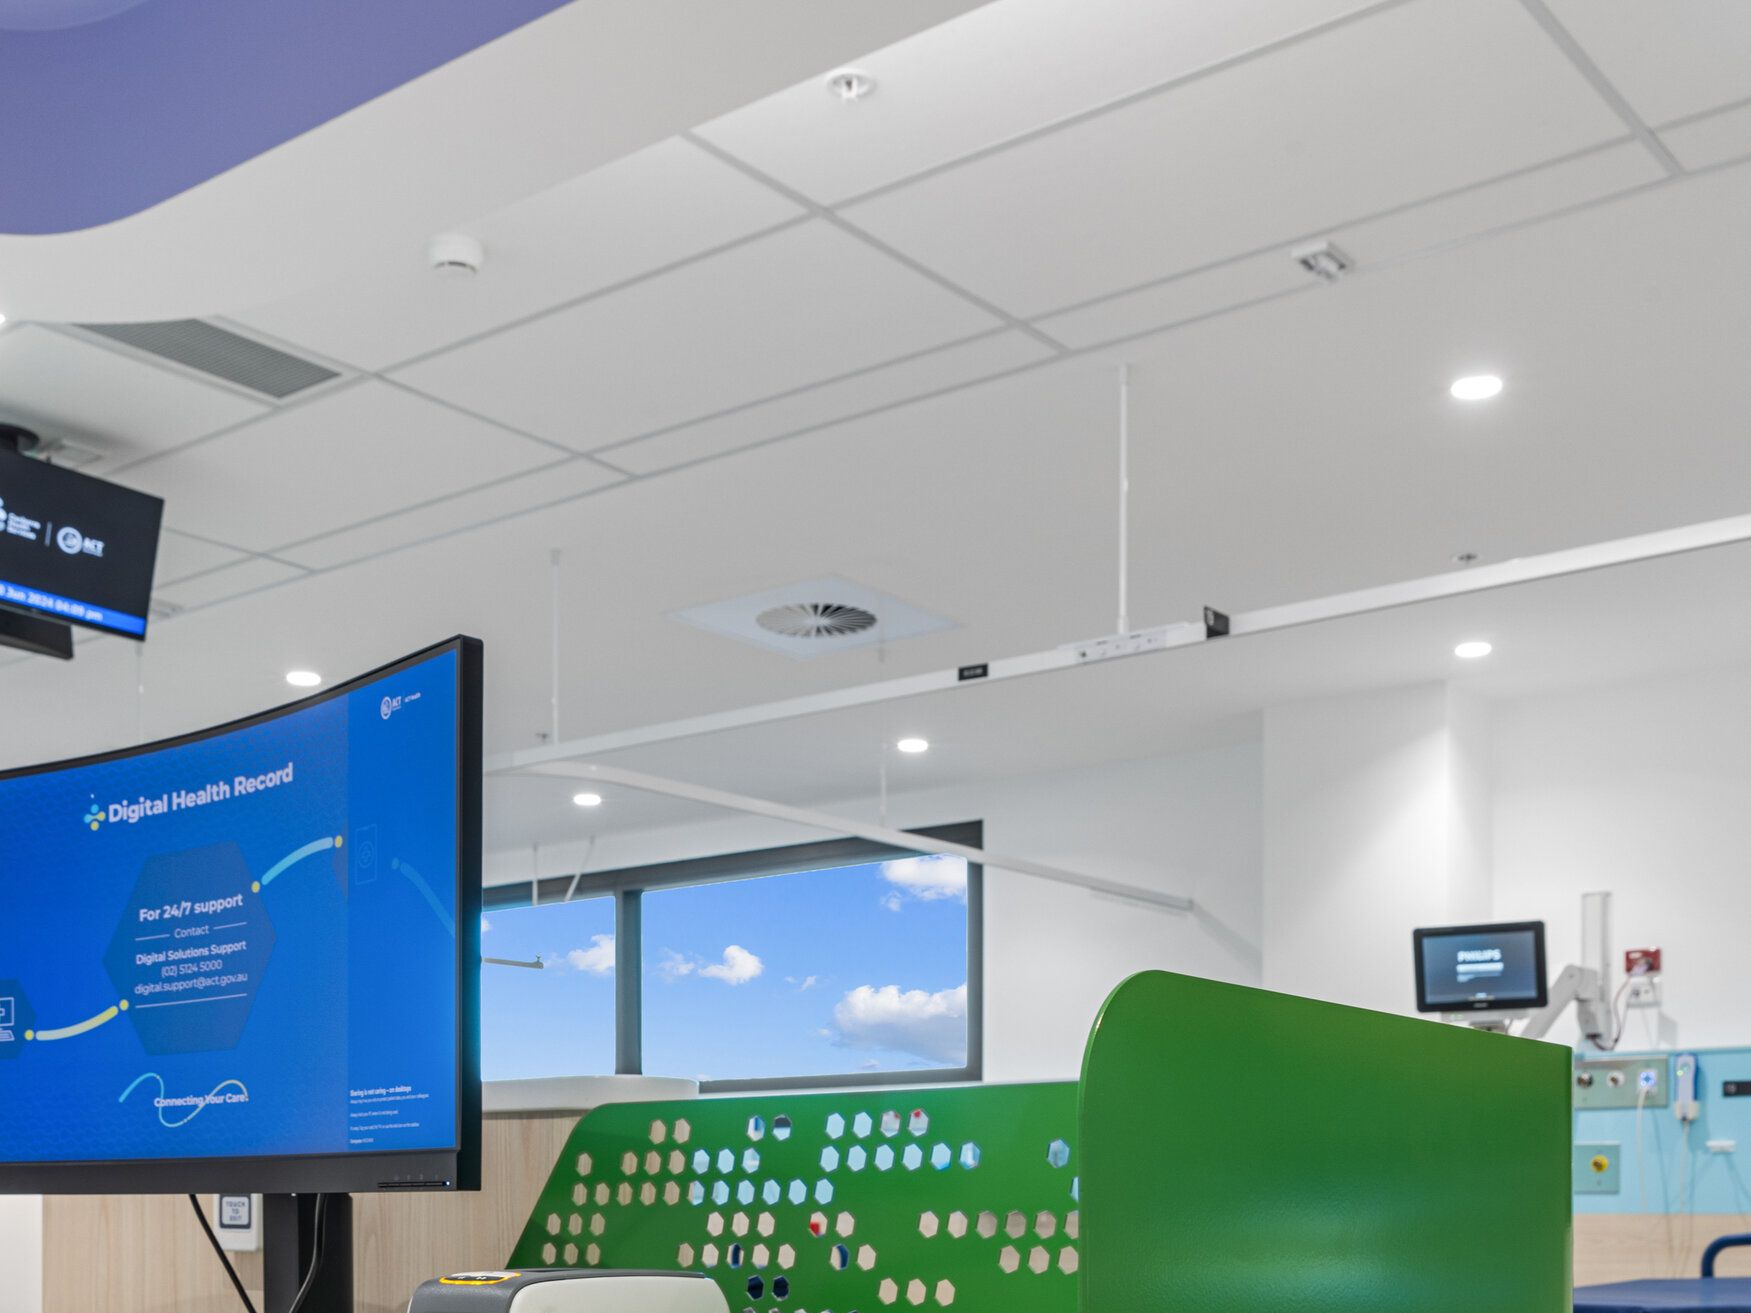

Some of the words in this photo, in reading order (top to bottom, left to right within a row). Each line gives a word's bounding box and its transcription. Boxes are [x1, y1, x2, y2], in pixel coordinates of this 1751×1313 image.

[108, 794, 168, 823] Digital
[171, 781, 231, 811] Health
[233, 762, 294, 796] Record
[139, 908, 161, 921] For
[163, 901, 192, 918] 24/7
[193, 894, 243, 914] support
[174, 925, 210, 938] Contact
[135, 951, 166, 966] Digital
[167, 946, 210, 960] Solutions
[210, 941, 247, 955] Support
[1457, 949, 1502, 962] PHILIPS
[161, 965, 178, 978] (02)
[179, 963, 198, 975] 5124
[199, 959, 223, 972] 5000
[134, 973, 248, 996] digital.support@act.gov.au
[154, 1095, 204, 1108] Connecting
[204, 1094, 225, 1105] Your
